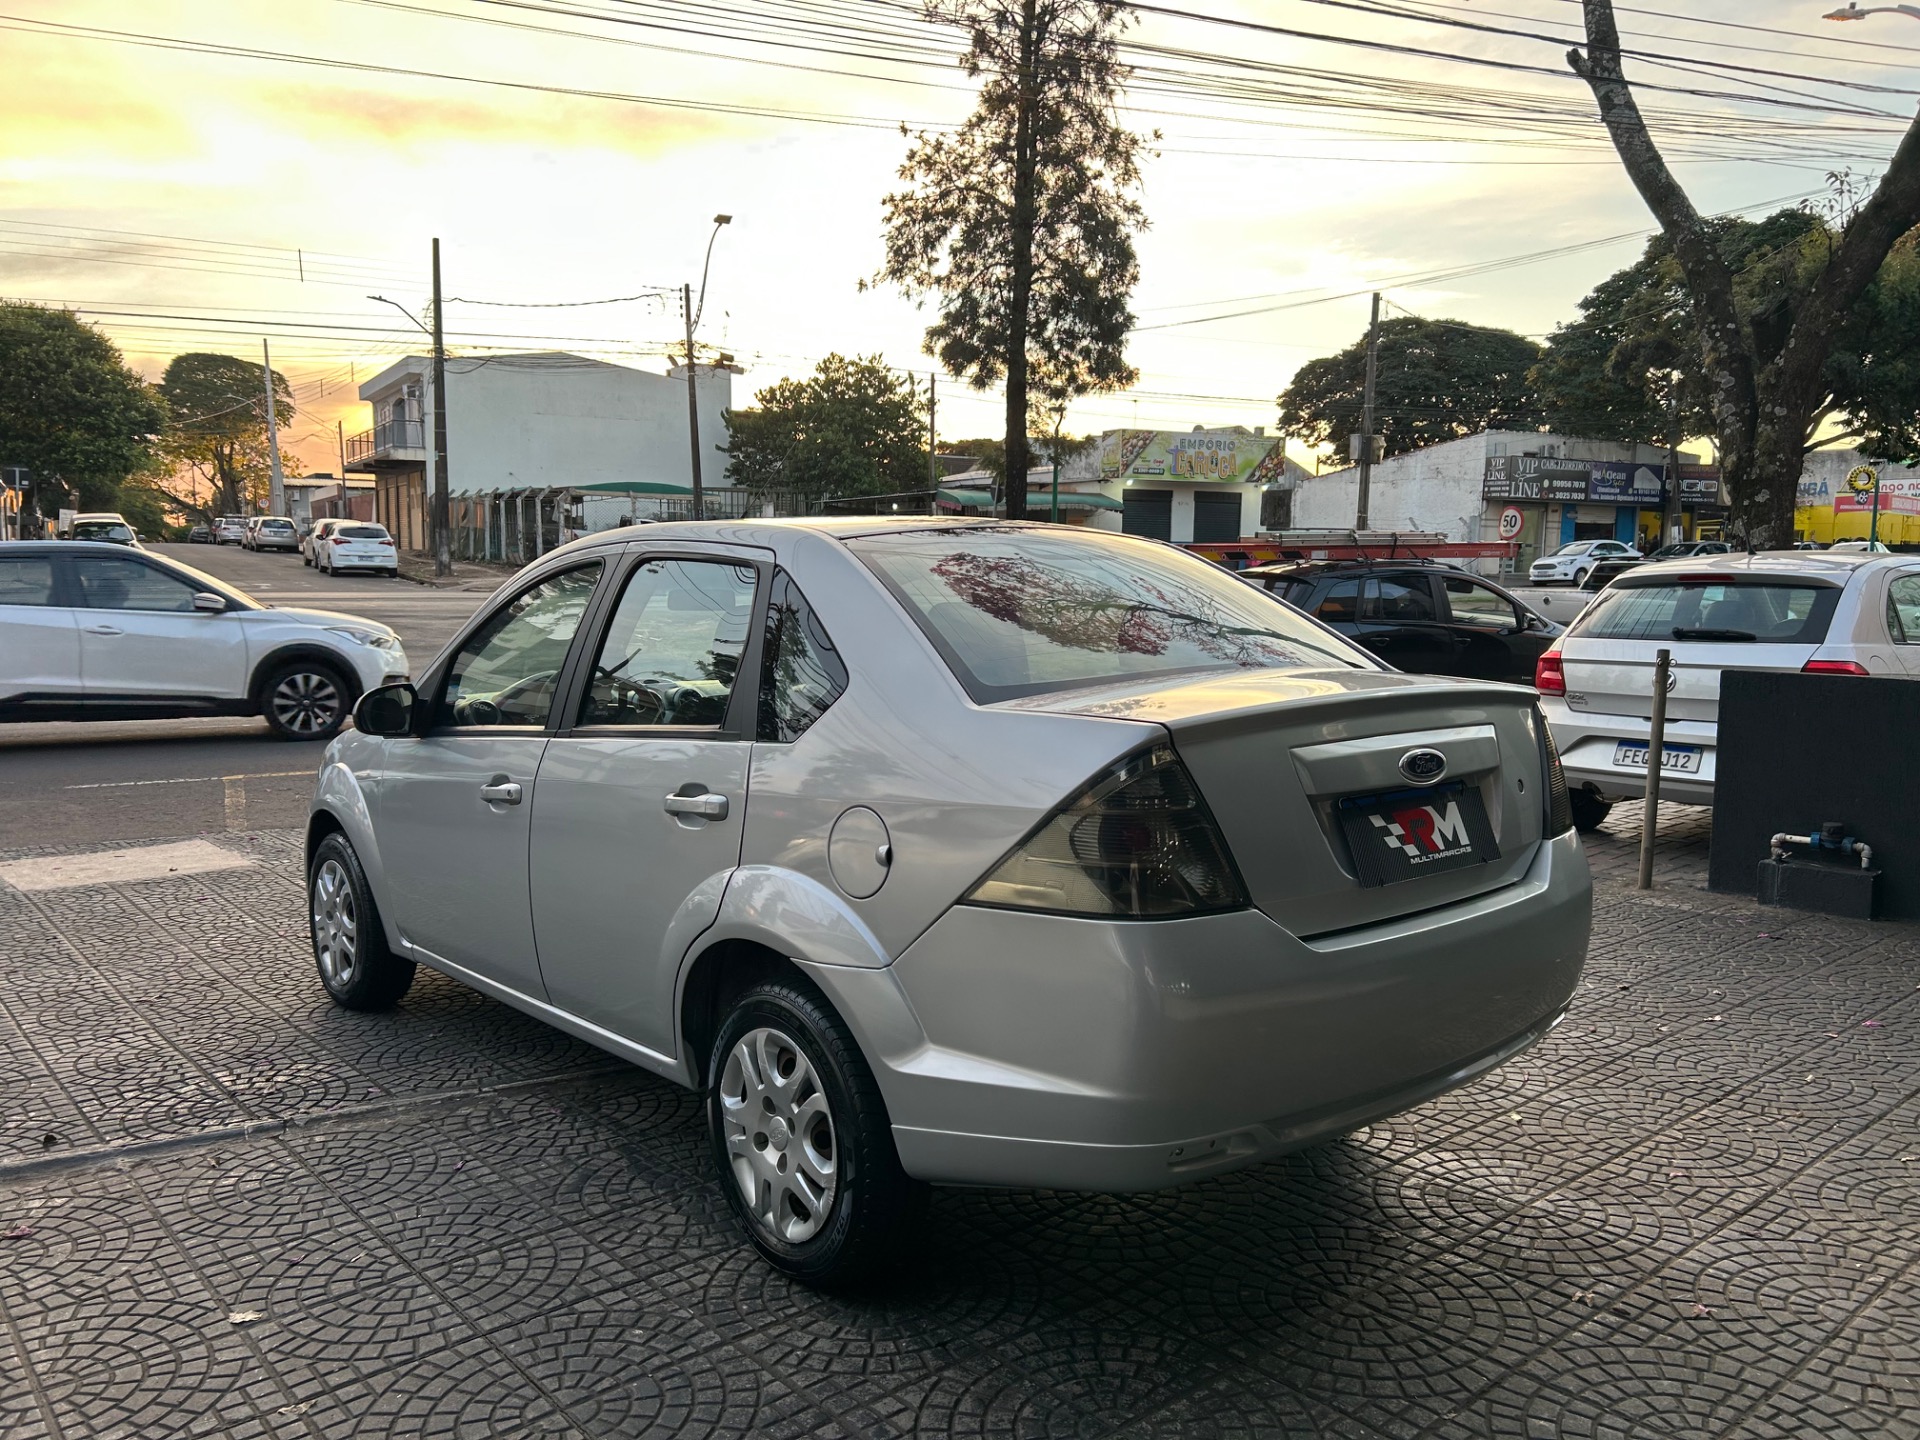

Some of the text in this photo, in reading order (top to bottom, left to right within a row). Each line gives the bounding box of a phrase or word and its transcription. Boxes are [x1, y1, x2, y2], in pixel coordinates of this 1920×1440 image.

[1176, 450, 1239, 479] CARIOCA
[1490, 458, 1505, 467] VIP
[1518, 458, 1538, 473] VIP
[1487, 470, 1506, 480] LINE
[1509, 481, 1541, 498] LINE
[1503, 515, 1517, 528] 50
[1415, 755, 1437, 773] Ford
[1622, 749, 1691, 769] FEQJ12
[1410, 846, 1472, 865] MULTIMARCAS
